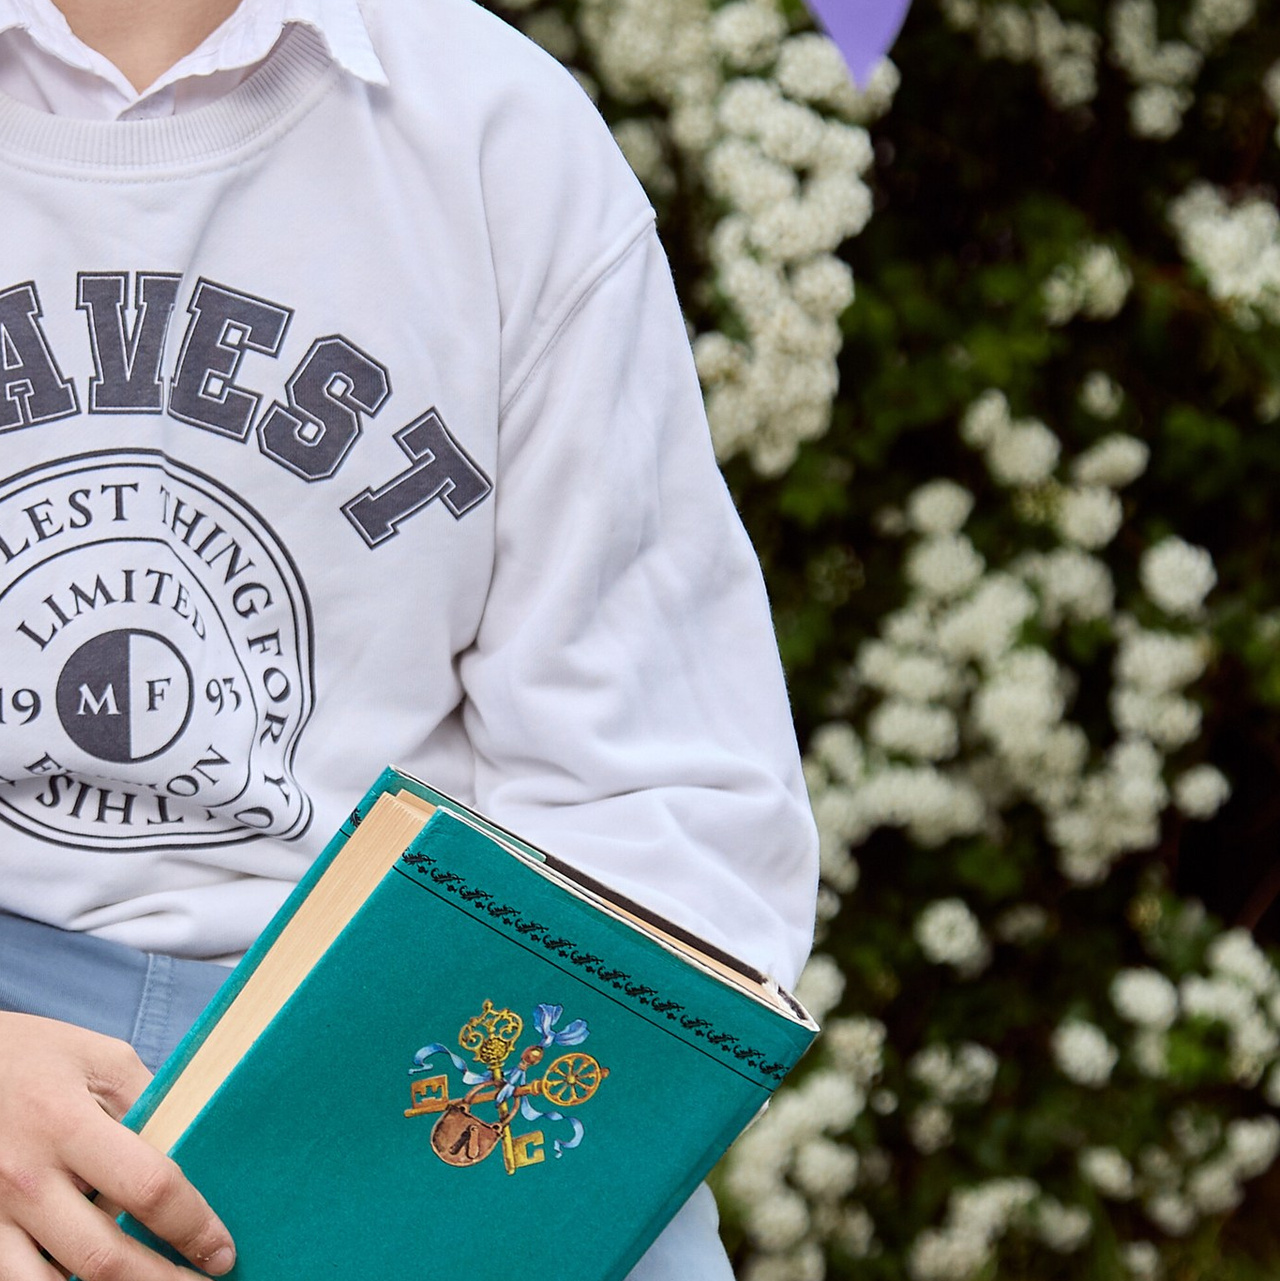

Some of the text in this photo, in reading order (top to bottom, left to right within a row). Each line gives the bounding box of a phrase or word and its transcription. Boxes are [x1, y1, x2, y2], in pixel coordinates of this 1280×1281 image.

[16, 569, 207, 652] LIMITED
[159, 485, 274, 619] THING
[246, 628, 292, 747] FOR
